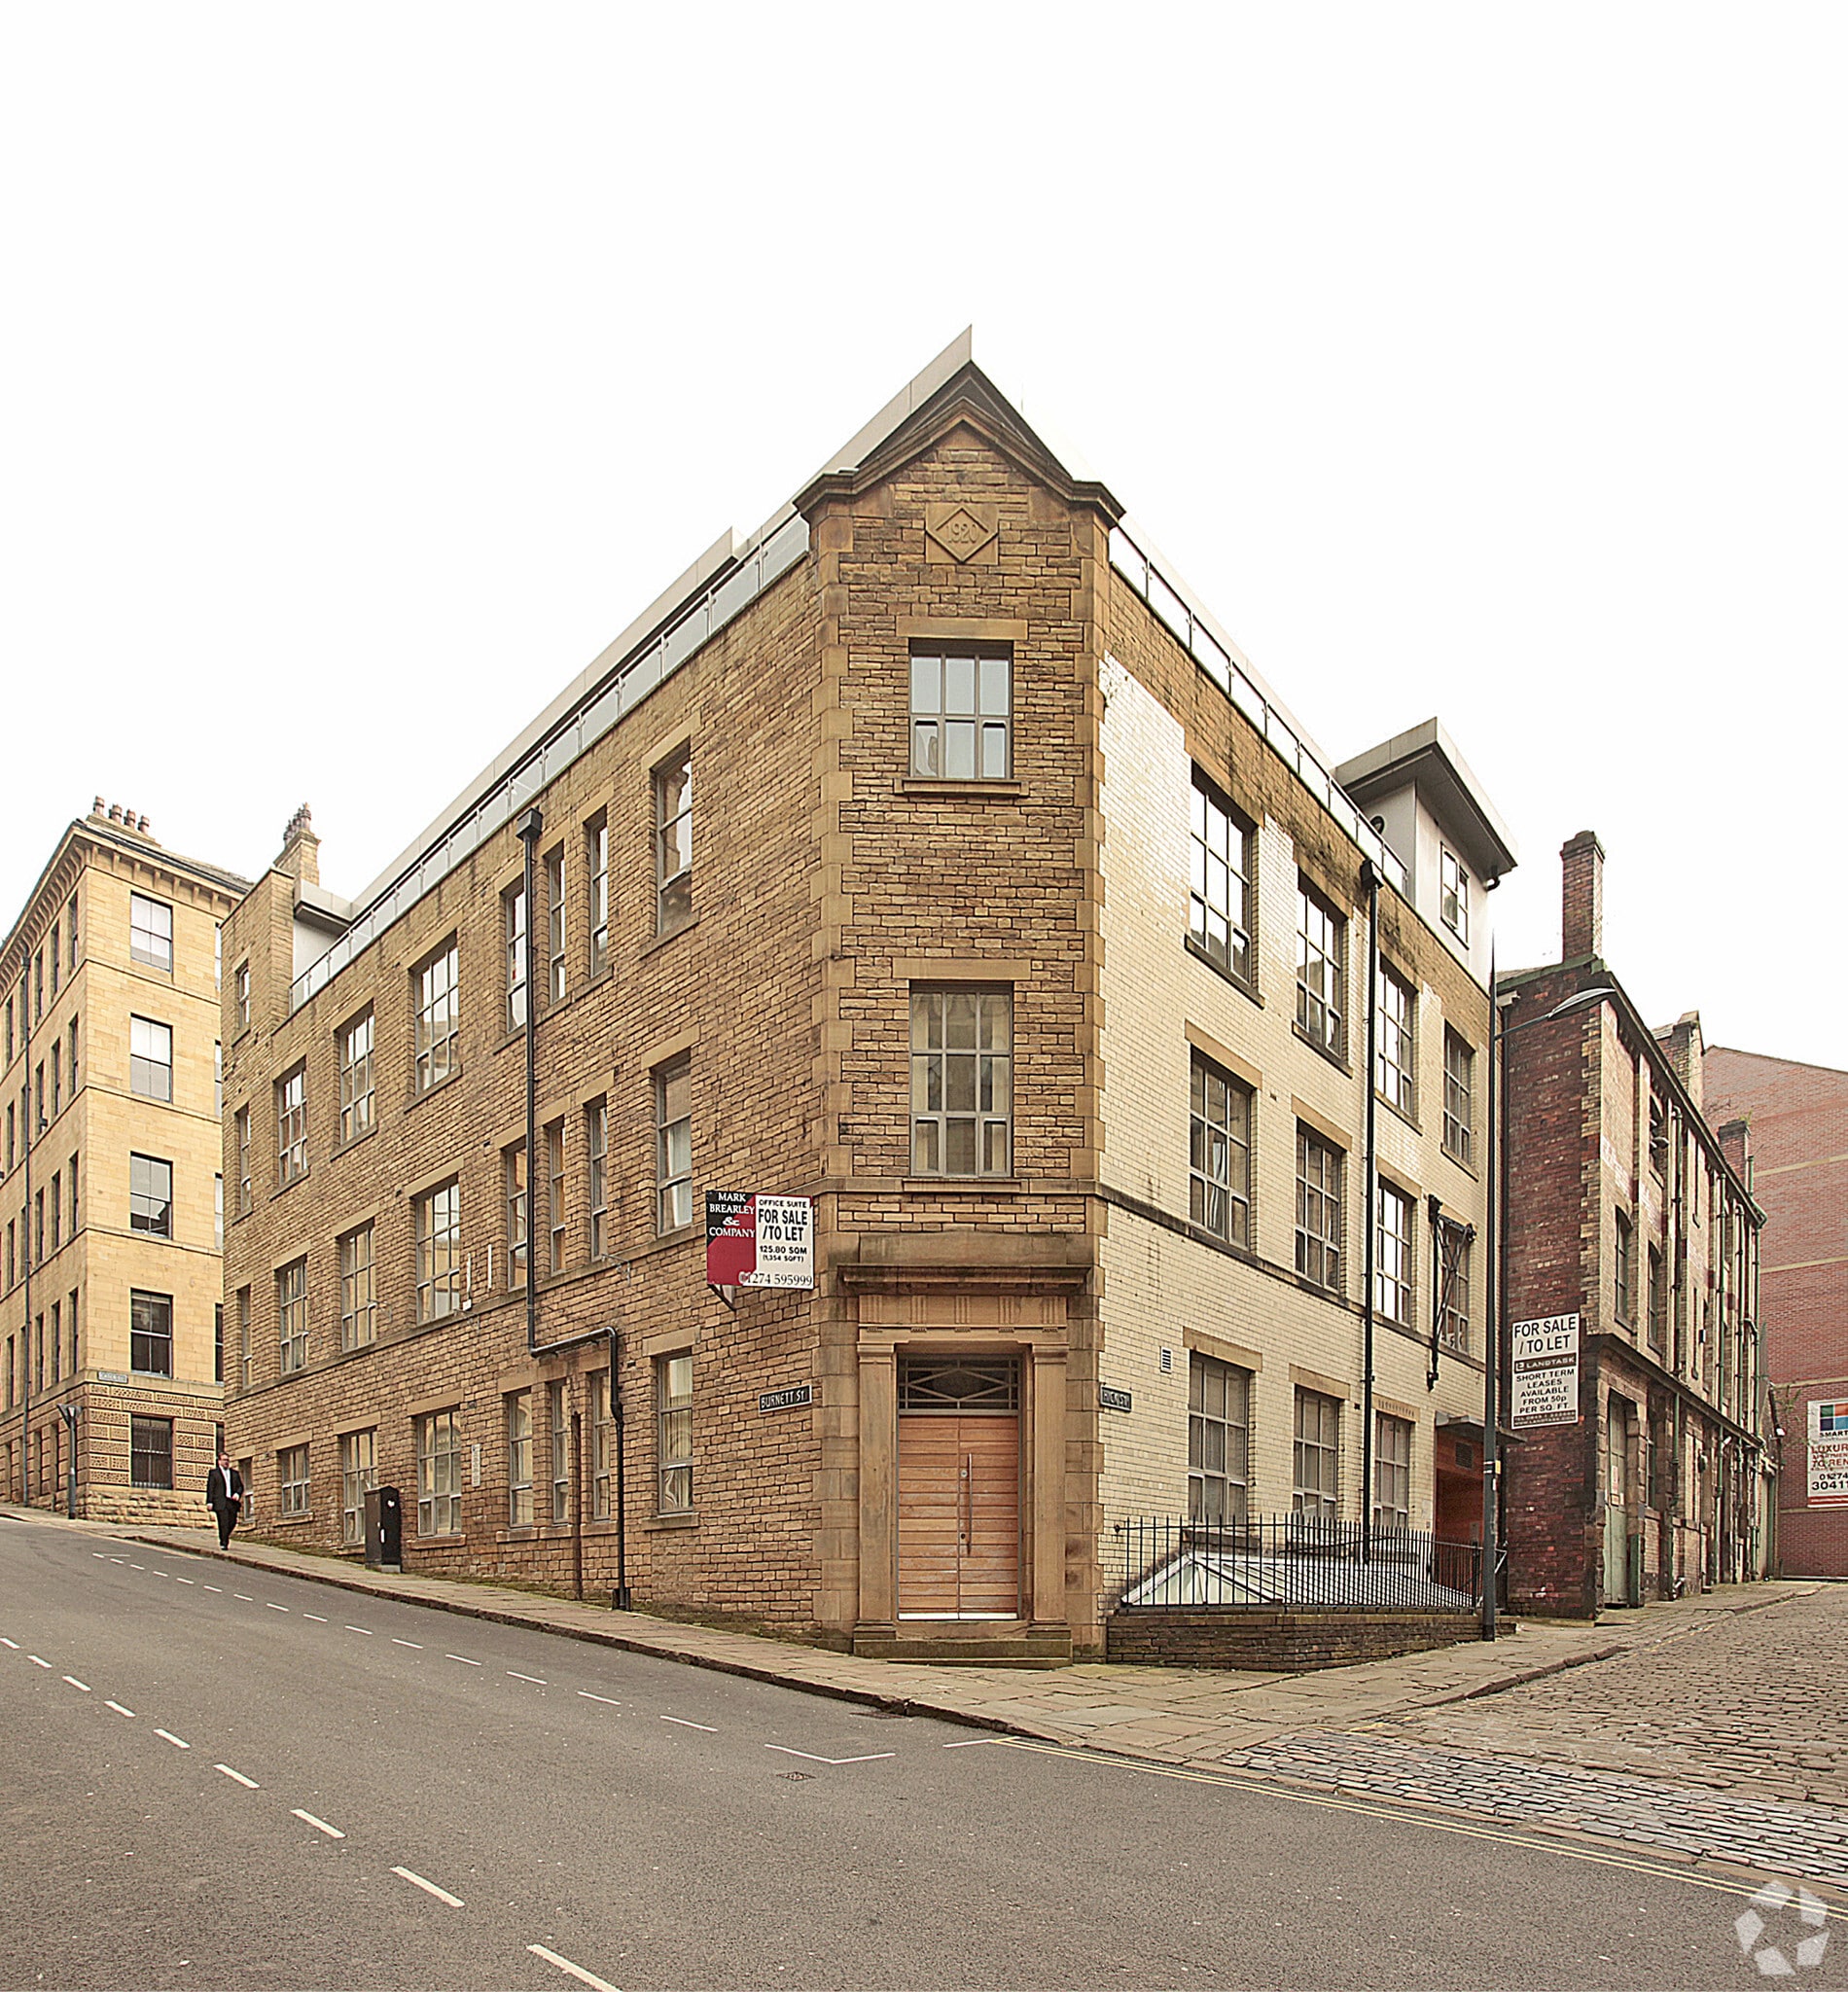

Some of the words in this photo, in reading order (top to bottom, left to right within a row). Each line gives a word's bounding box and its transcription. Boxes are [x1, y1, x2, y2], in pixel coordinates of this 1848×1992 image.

[718, 1192, 746, 1202] MARK
[709, 1204, 756, 1215] BREARLEY
[722, 1216, 740, 1226] &
[759, 1209, 778, 1224] FOR
[782, 1210, 808, 1226] SALE
[709, 1227, 756, 1238] COMPANY
[785, 1227, 804, 1241] LET
[774, 1275, 812, 1286] 595999
[1514, 1323, 1540, 1338] FOR
[1543, 1316, 1576, 1334] SALE
[1546, 1334, 1571, 1351] LET
[1526, 1356, 1575, 1369] LANDTASK
[1516, 1372, 1546, 1382] SHORT
[1549, 1369, 1574, 1378] TERM
[1527, 1378, 1562, 1389] LEASES
[1520, 1386, 1569, 1398] AVAILABLE
[761, 1391, 794, 1408] BURNETT
[1523, 1396, 1548, 1405] FROM
[1519, 1405, 1537, 1413] PER
